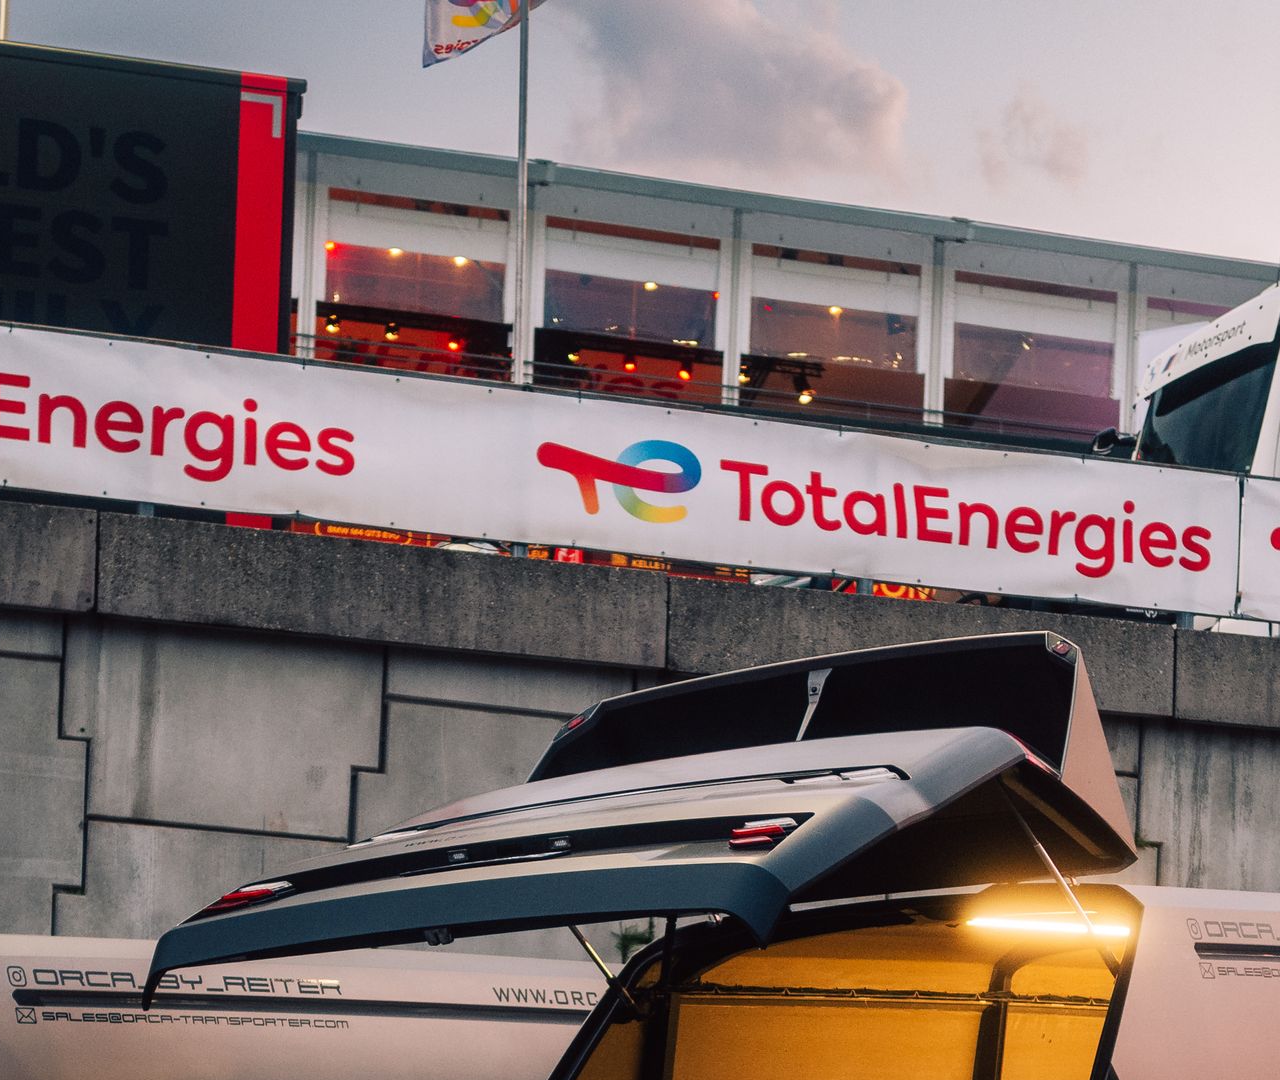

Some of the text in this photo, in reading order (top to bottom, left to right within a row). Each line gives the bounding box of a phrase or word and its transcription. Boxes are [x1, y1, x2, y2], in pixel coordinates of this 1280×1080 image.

[721, 459, 1212, 578] TotalEnergies
[33, 968, 342, 996] ORCA_BY_REITER
[493, 987, 599, 1007] WWW.ORC
[42, 1011, 350, 1030] SALES@ORCA-TRANSPORTER.COM
